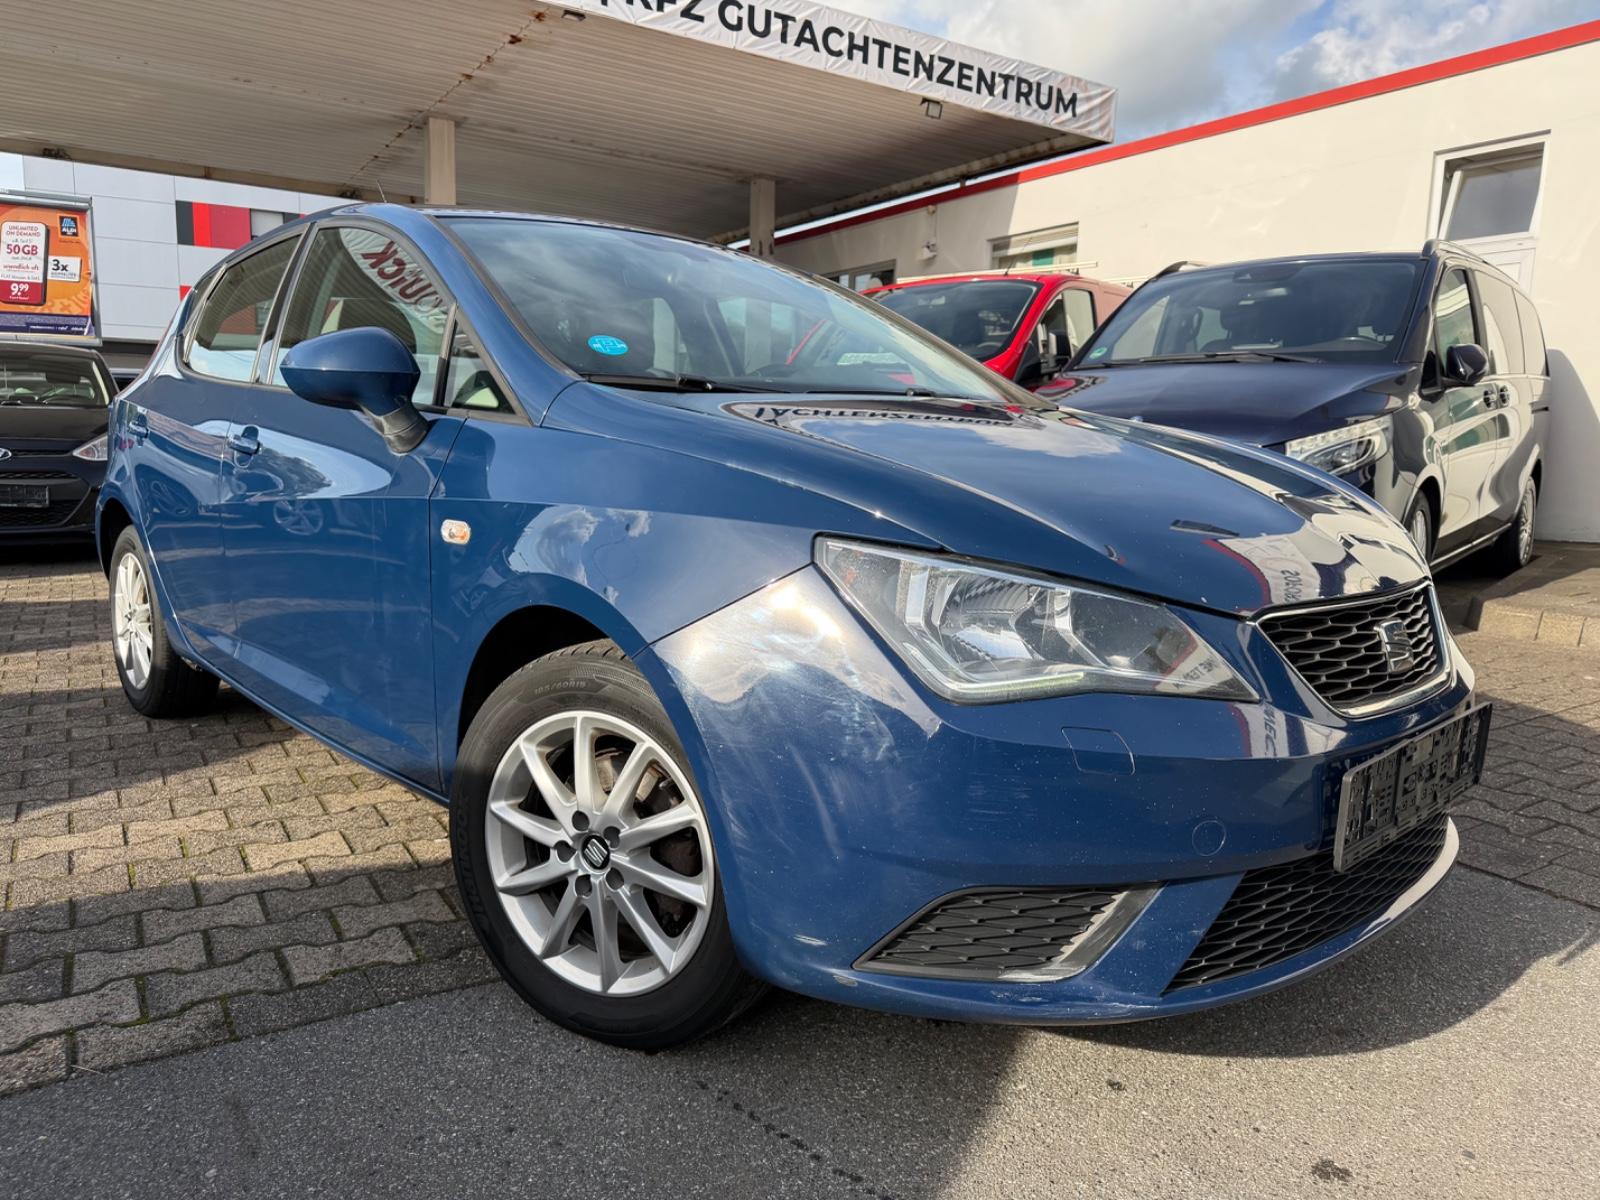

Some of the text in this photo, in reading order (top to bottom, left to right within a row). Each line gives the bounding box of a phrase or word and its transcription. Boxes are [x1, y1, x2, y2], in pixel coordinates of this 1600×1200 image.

[718, 0, 1078, 118] GUTACHTENZENTRUM
[6, 243, 39, 256] 50 GB
